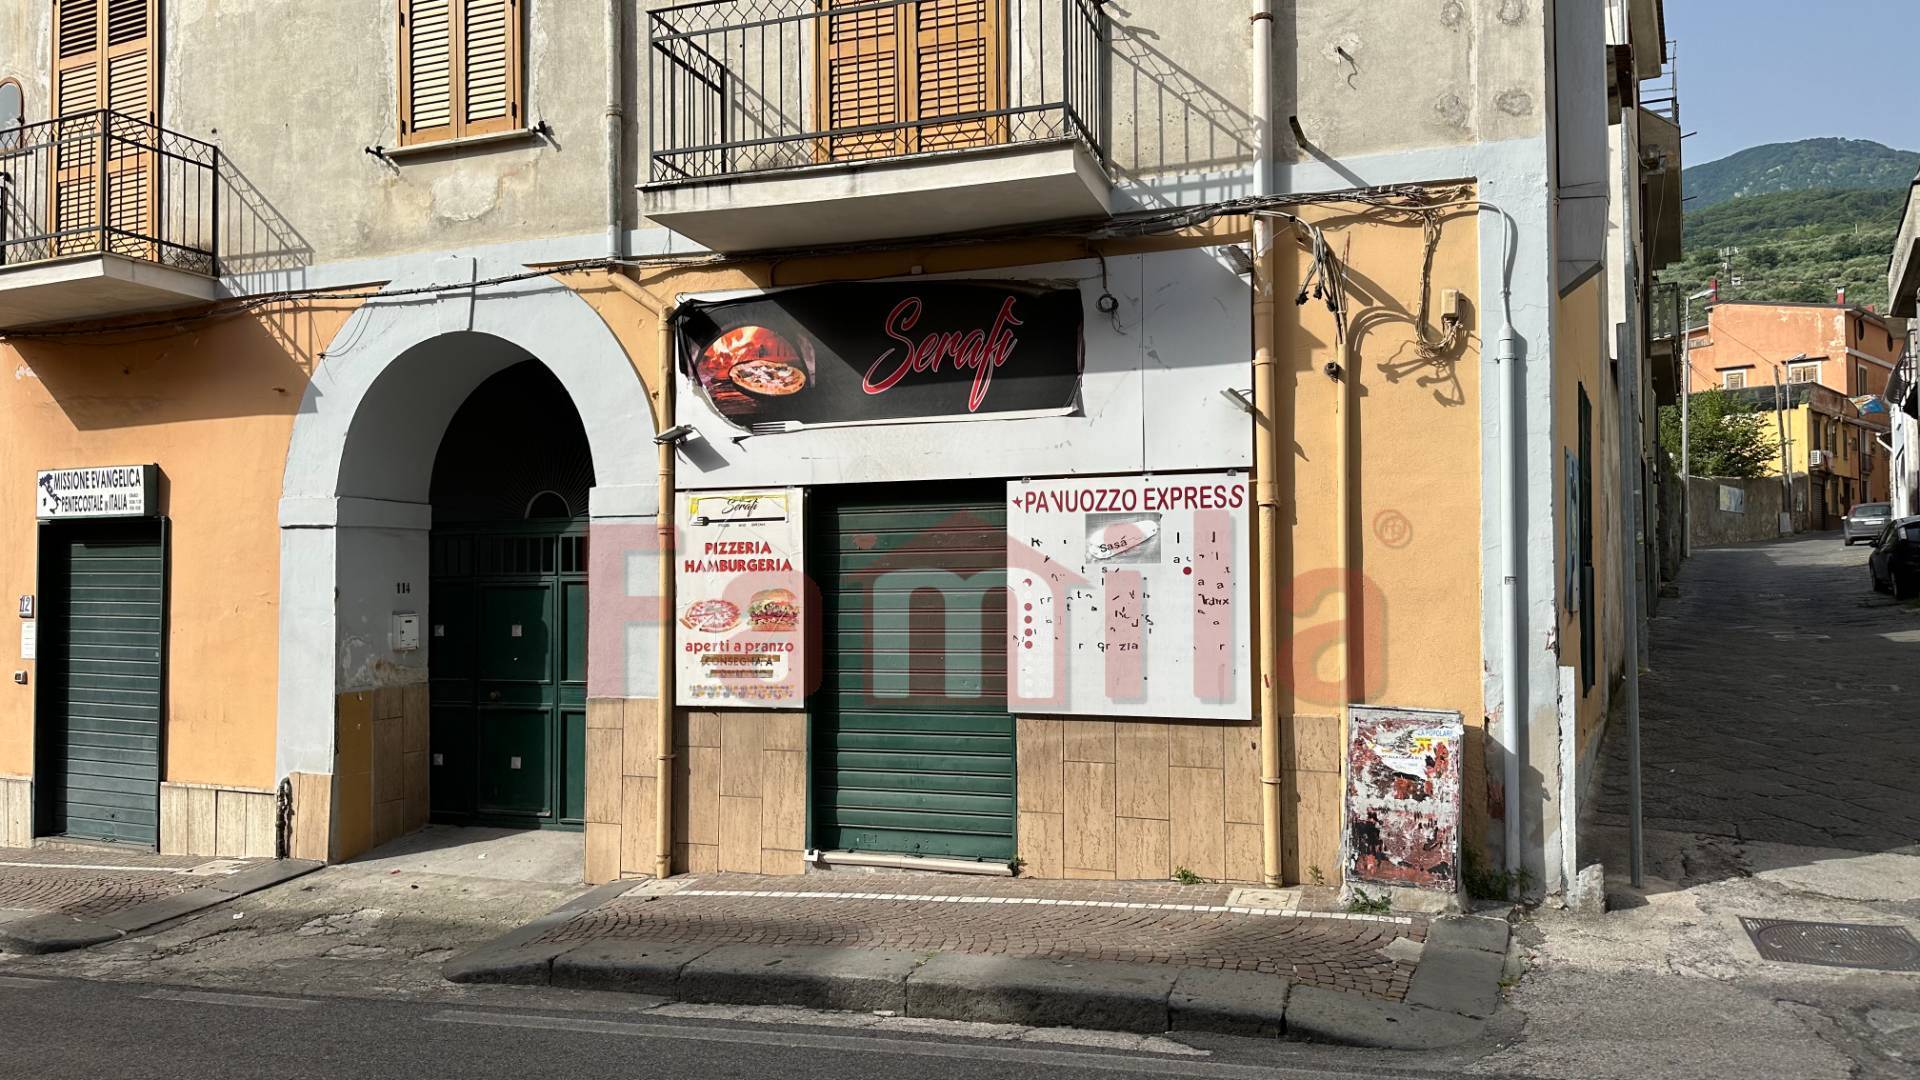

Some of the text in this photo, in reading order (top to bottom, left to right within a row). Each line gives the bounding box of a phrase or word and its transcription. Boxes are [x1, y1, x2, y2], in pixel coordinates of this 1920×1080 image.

[862, 296, 1024, 413] Serafi
[54, 467, 141, 490] MISSIONE EVANGELICA
[61, 494, 103, 512] PENTECOSTALE
[109, 493, 128, 510] ITALIA
[1025, 484, 1245, 513] PANUOZZO EXPRESS
[704, 541, 772, 555] PIZZERIA
[684, 559, 793, 573] HAMBURGERIA
[685, 640, 794, 655] aperti a pranzo
